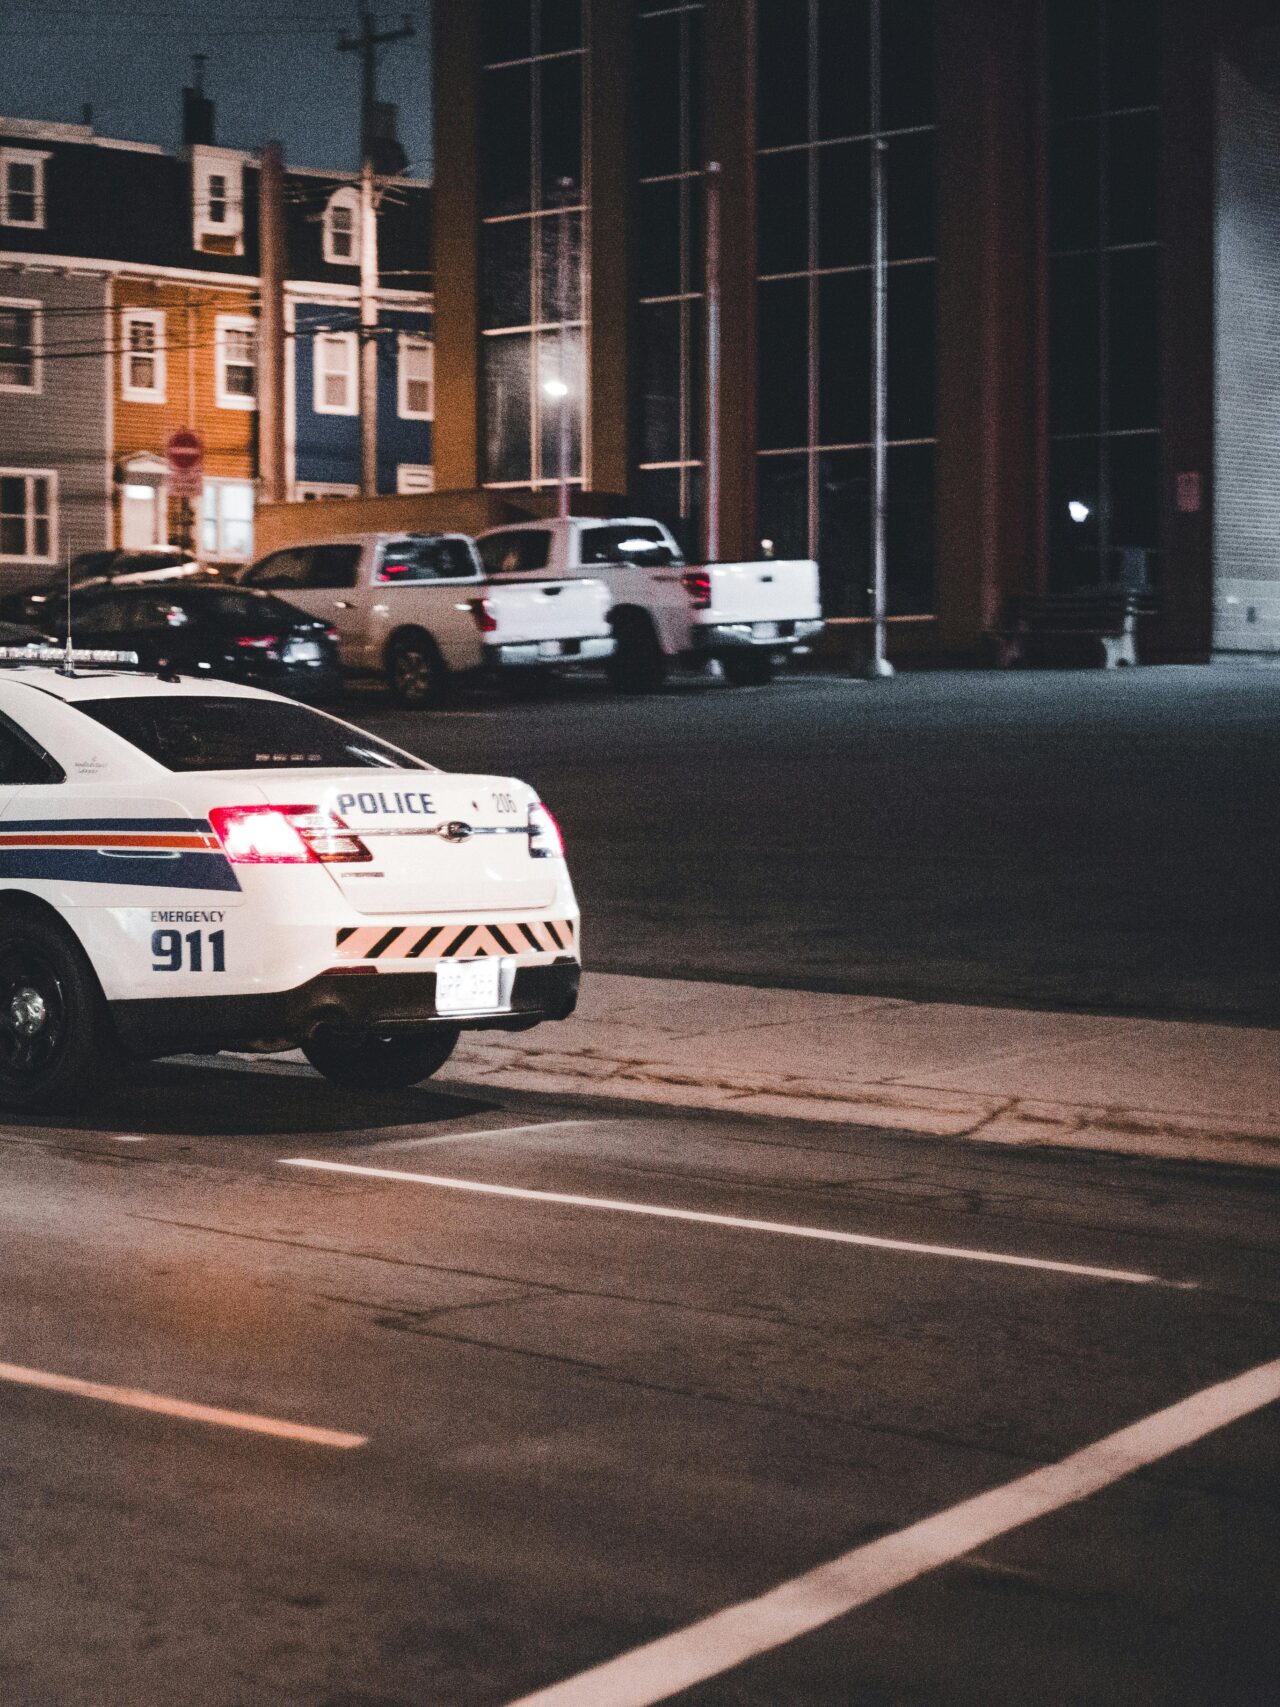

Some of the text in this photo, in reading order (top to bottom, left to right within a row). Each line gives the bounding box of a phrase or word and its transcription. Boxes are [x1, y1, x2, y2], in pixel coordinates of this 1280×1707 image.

[337, 792, 436, 815] POLICE
[492, 793, 517, 813] 206
[151, 911, 225, 922] EMERGENCY
[152, 929, 226, 972] 911
